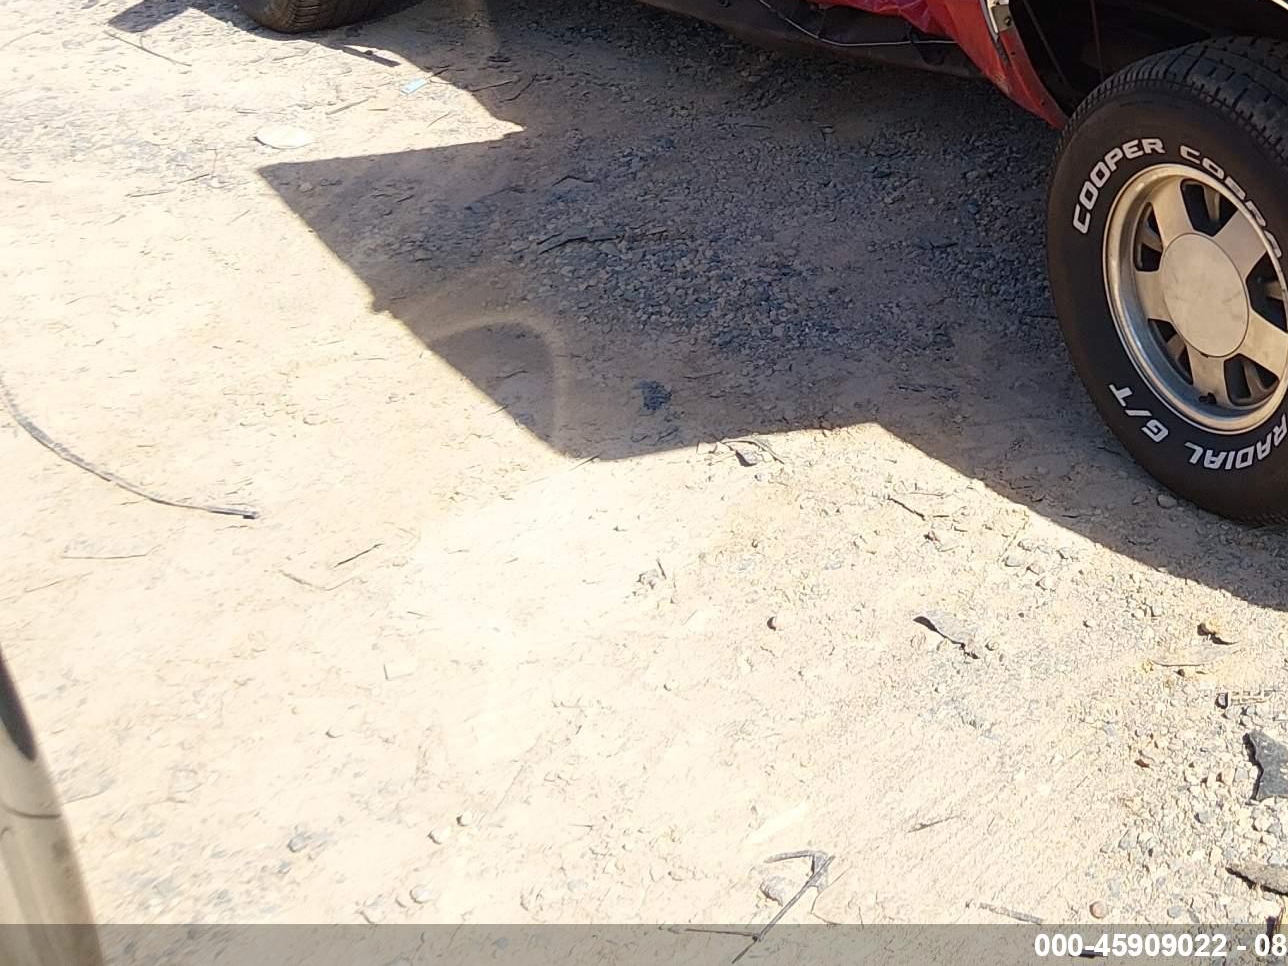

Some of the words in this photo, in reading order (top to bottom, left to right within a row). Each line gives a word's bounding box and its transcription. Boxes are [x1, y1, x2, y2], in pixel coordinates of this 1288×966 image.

[1072, 138, 1166, 234] COOPER
[1108, 384, 1169, 443] G/T
[1184, 413, 1288, 470] RADIAL
